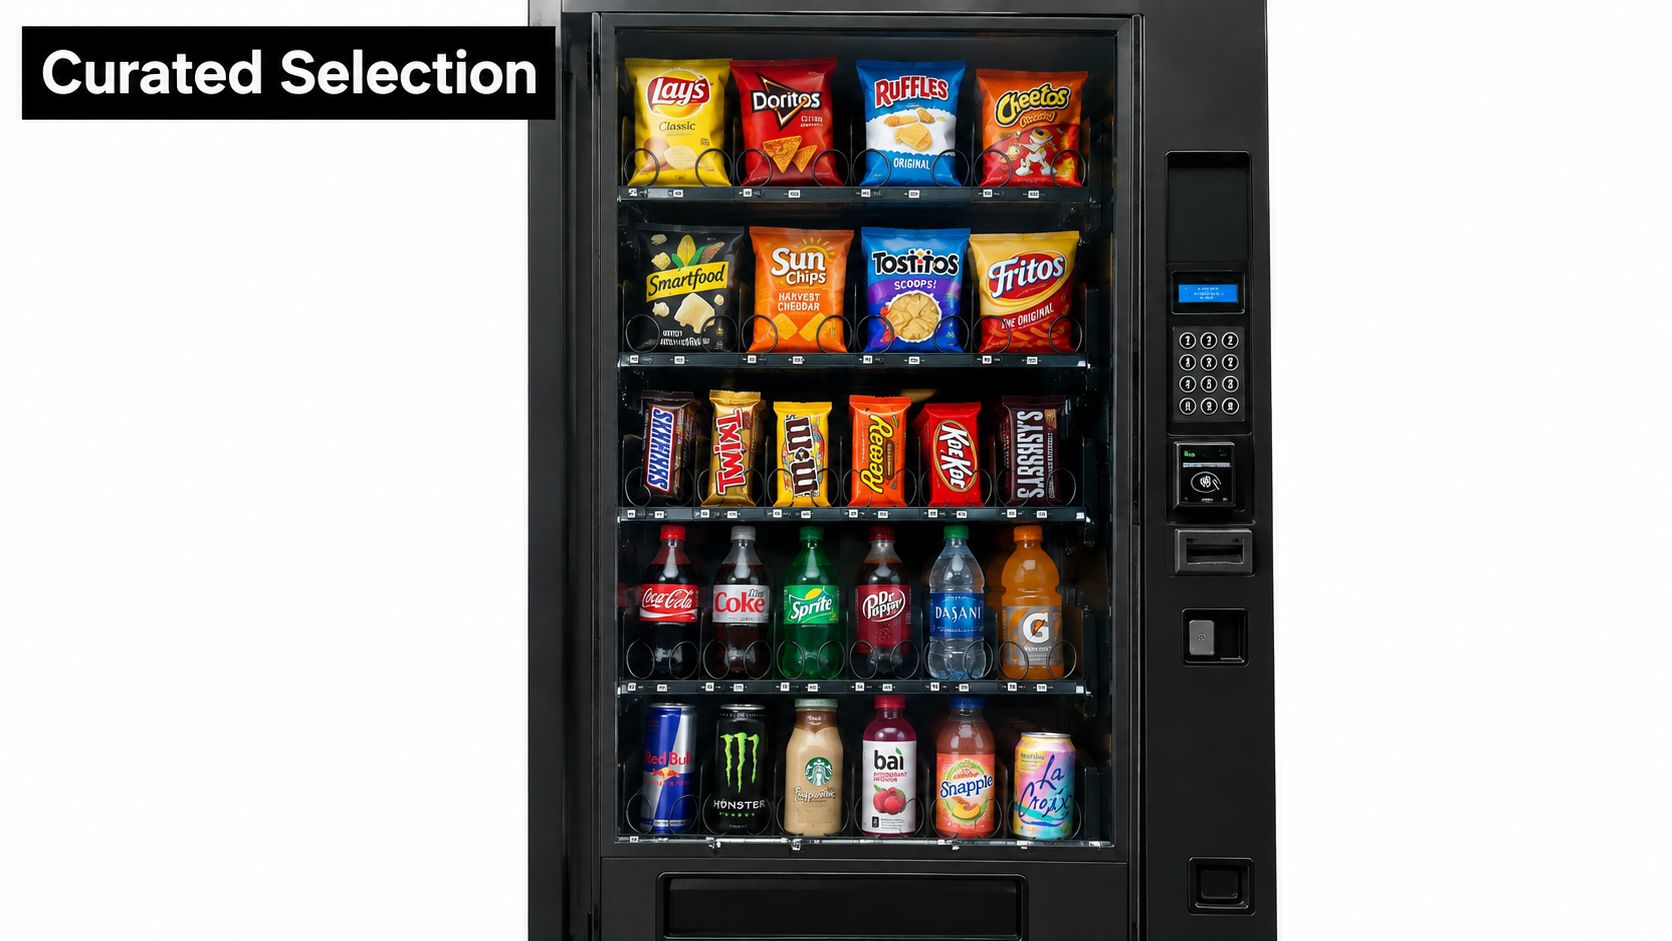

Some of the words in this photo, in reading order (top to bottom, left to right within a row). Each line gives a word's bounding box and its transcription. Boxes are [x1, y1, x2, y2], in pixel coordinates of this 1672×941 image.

[651, 76, 707, 106] Lay's
[752, 90, 820, 111] Doritos
[875, 76, 948, 107] RUFFLES
[997, 86, 1070, 125] Cheetos
[658, 121, 696, 132] Classic
[894, 158, 930, 171] ORIGINAL
[771, 247, 826, 276] Sun
[648, 264, 726, 296] Smartfood
[787, 271, 826, 286] Chips
[895, 279, 937, 290] SCOOPS!
[989, 255, 1065, 298] Fritos
[642, 588, 694, 609] Coca-Cola
[714, 591, 766, 613] Coke
[791, 596, 833, 620] Sprite
[874, 747, 904, 770] bai
[1039, 754, 1065, 791] La
[940, 774, 994, 798] Snapple
